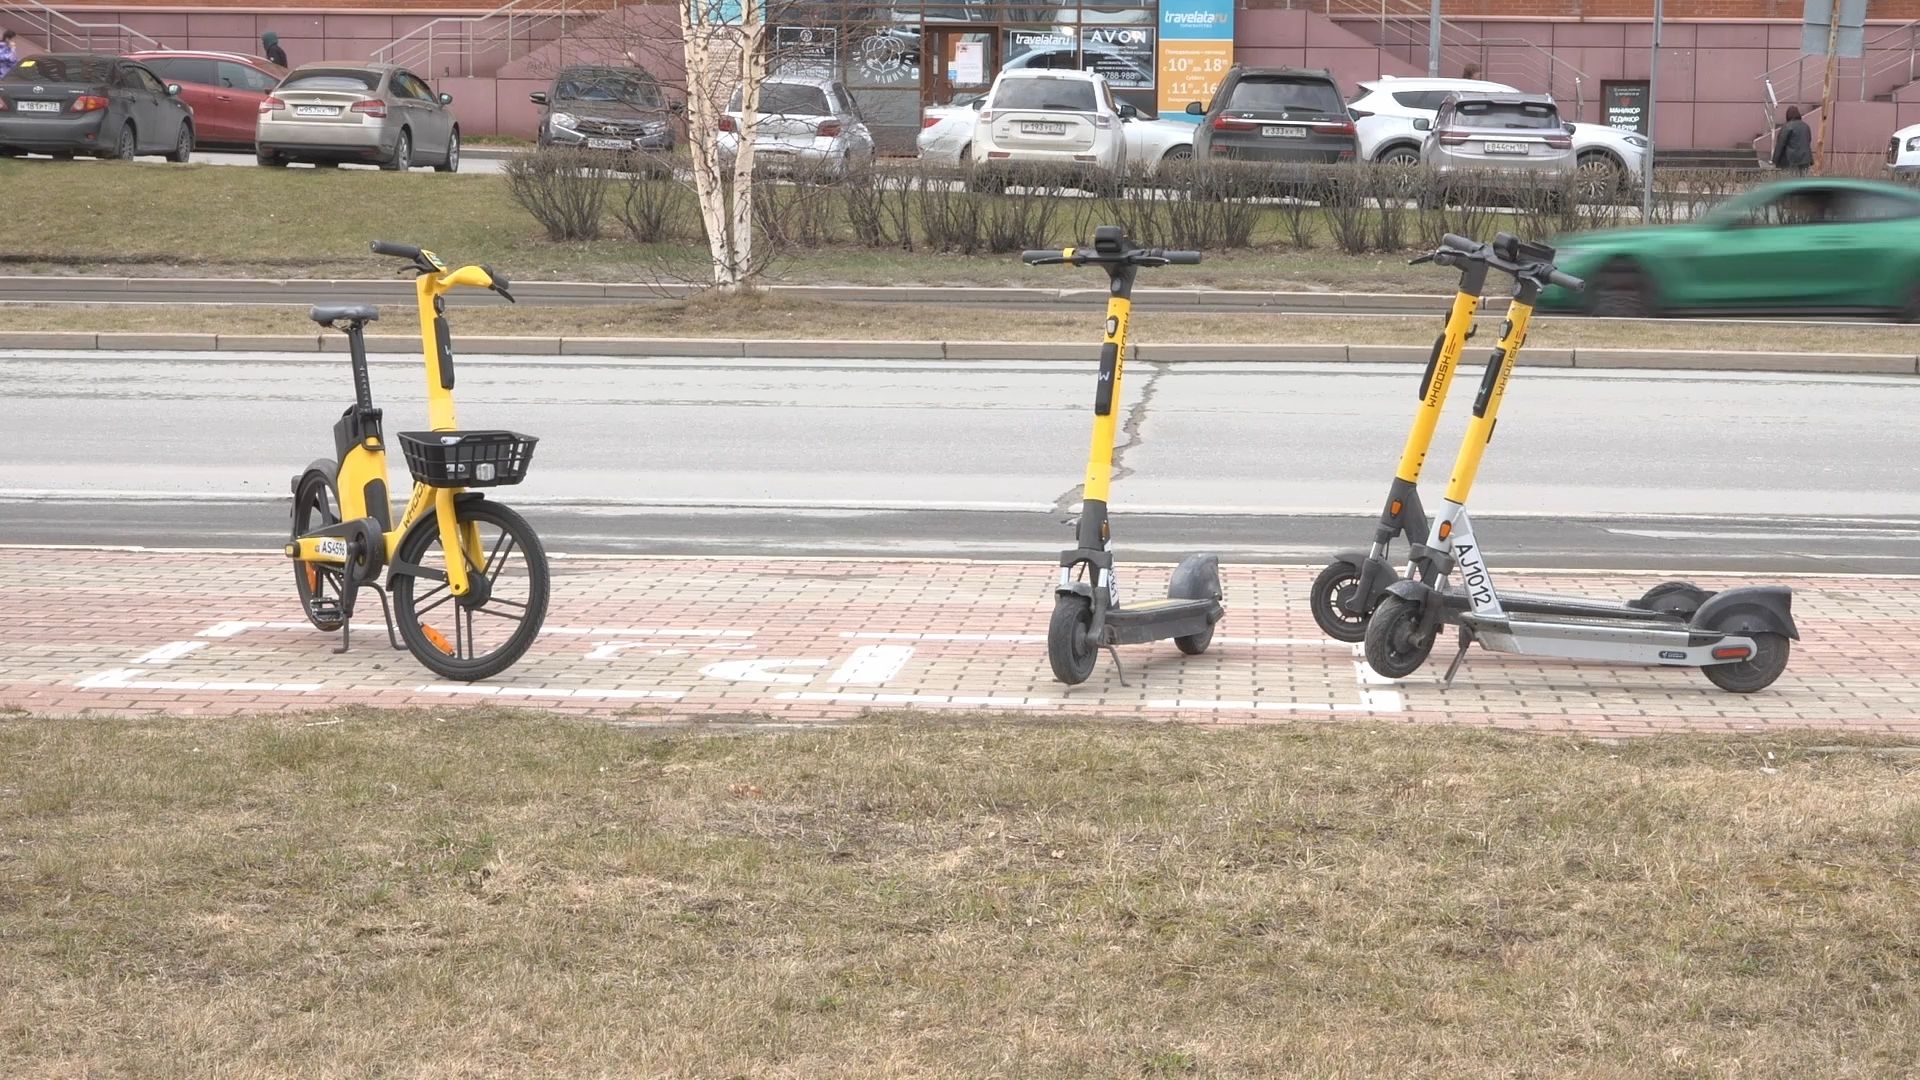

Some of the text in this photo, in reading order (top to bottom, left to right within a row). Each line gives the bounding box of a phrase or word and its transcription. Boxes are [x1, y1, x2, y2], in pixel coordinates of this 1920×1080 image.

[1090, 30, 1146, 43] AVON
[1609, 115, 1640, 123] ПЕДИКЮР
[1427, 354, 1452, 408] WHOOSH
[403, 483, 425, 529] WHOO
[1455, 544, 1492, 608] AJ1012
